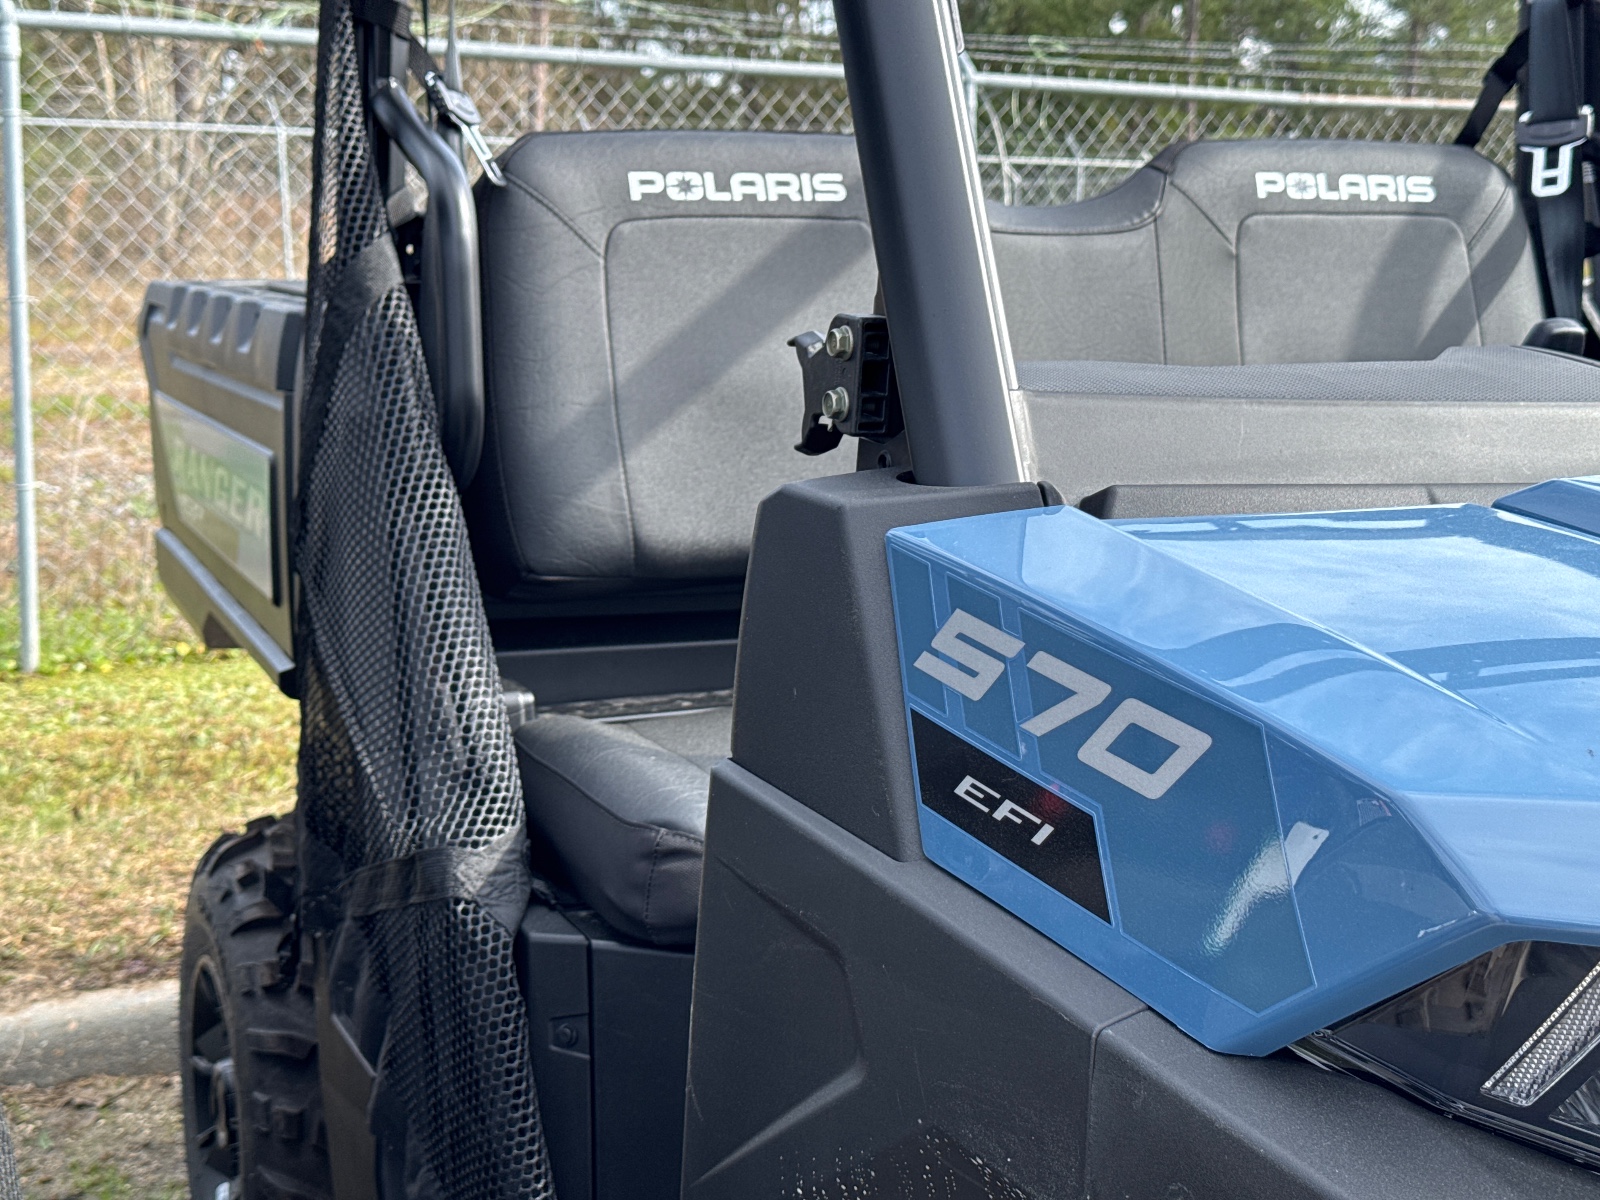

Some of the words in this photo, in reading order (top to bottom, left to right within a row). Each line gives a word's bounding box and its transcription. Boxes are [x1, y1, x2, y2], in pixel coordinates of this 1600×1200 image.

[627, 171, 847, 202] POLARIS
[1255, 171, 1437, 203] POLARIS
[913, 608, 1212, 800] 570
[954, 775, 1054, 846] EFI
